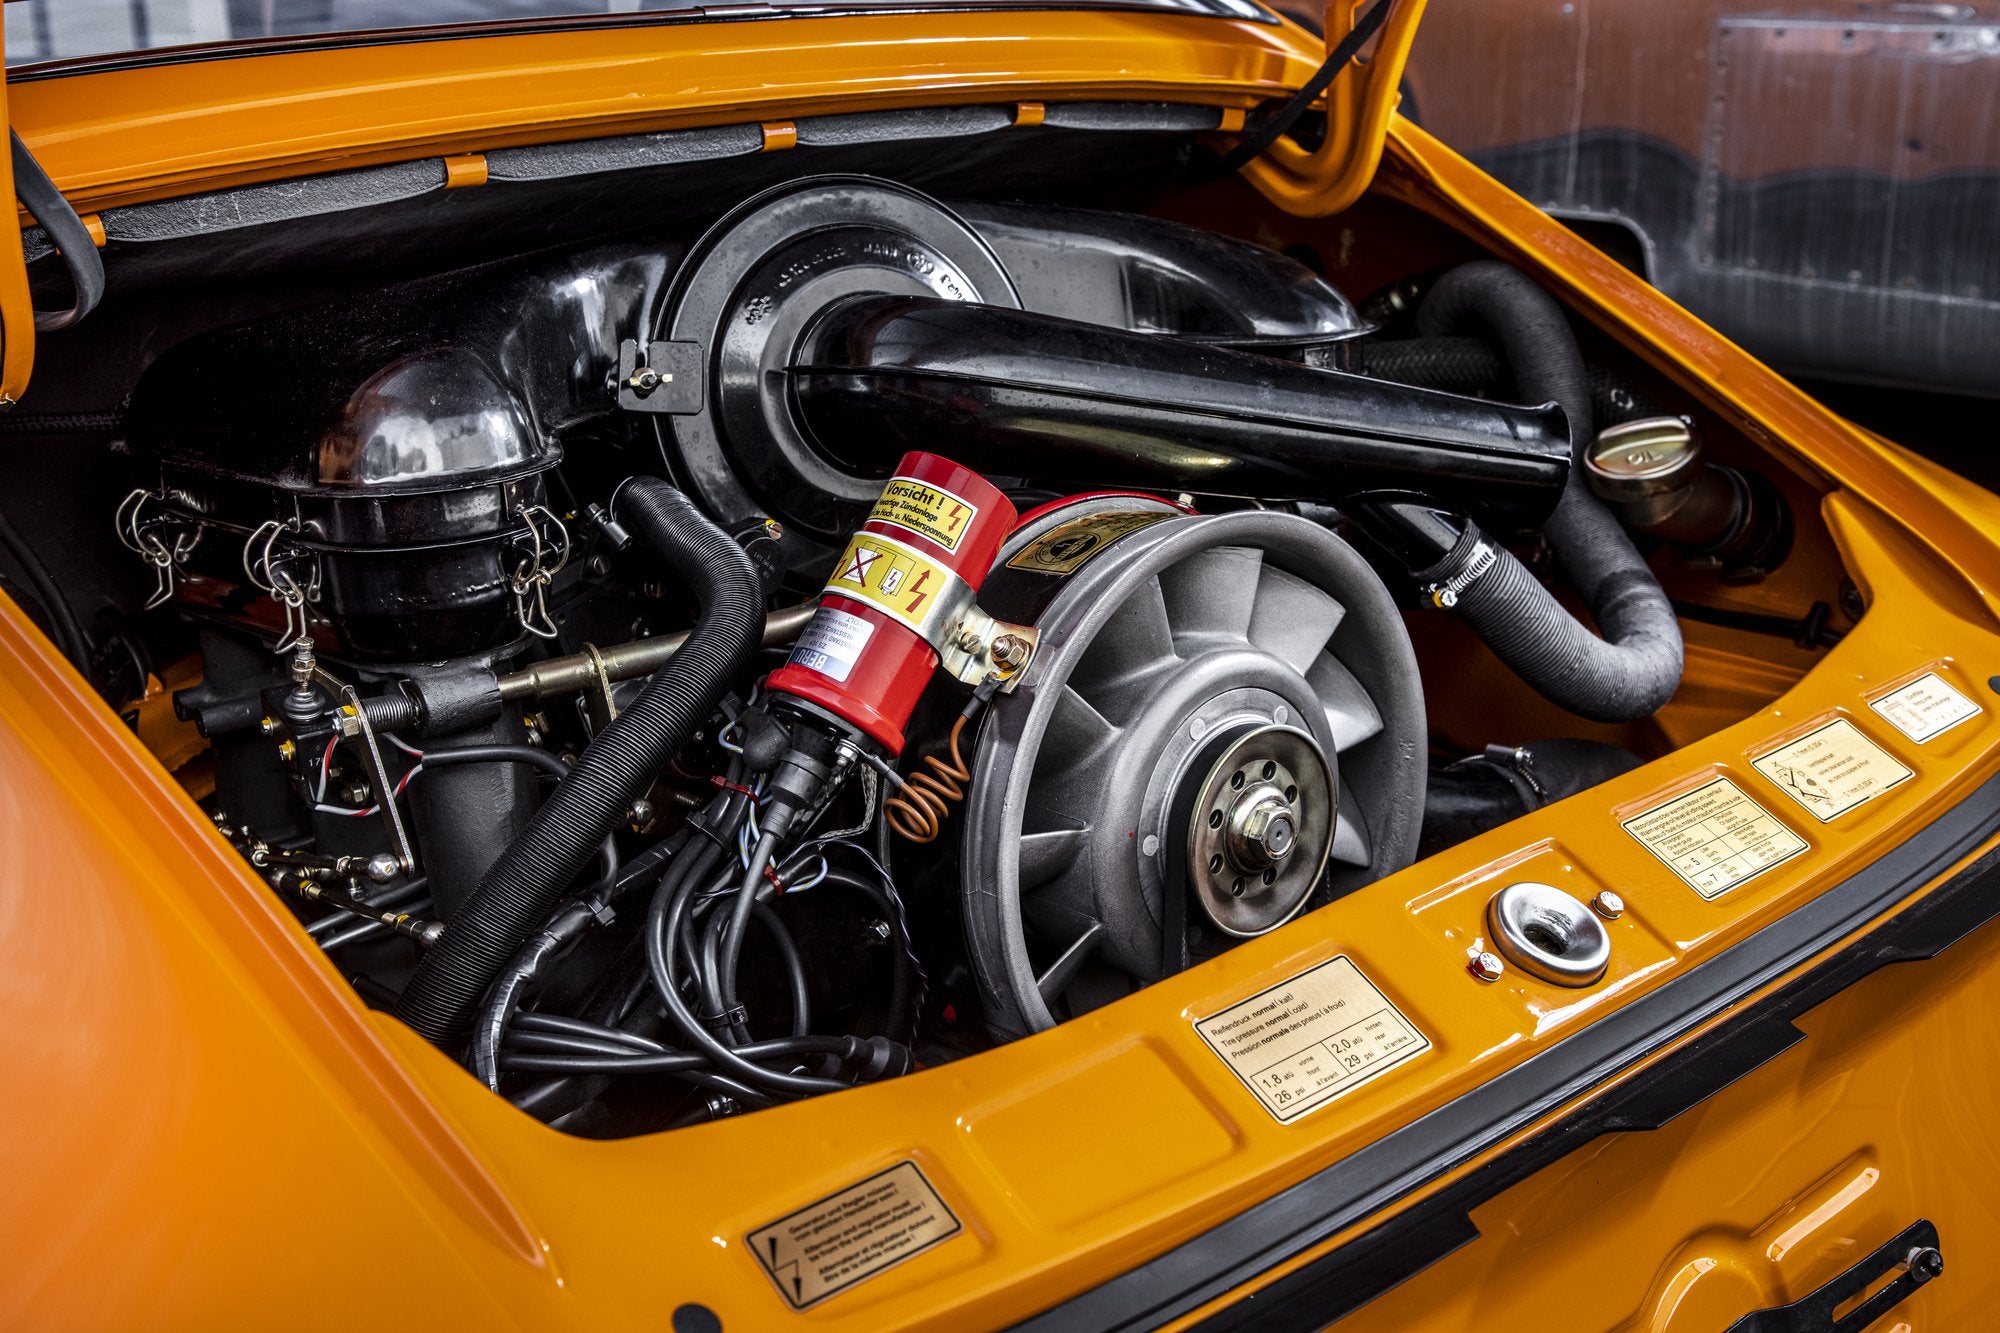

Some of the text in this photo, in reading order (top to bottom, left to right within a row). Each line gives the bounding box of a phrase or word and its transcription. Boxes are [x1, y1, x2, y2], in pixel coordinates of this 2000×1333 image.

[1627, 450, 1664, 466] OIL
[887, 482, 935, 505] Vorsicht
[899, 500, 938, 522] Zündanlage
[901, 513, 955, 546] Niederspannung
[796, 649, 828, 670] BERU
[308, 757, 324, 767] 17
[1690, 857, 1700, 866] 5
[1709, 873, 1718, 881] 7
[1211, 1015, 1251, 1036] Reifendruck
[1252, 1002, 1277, 1018] normal
[1365, 1021, 1382, 1031] hinten
[1221, 1038, 1237, 1047] Tire
[1235, 1025, 1265, 1042] pressure
[1265, 1011, 1290, 1027] normal
[1231, 1042, 1262, 1058] Pression
[1261, 1028, 1290, 1044] normale
[1288, 1022, 1302, 1031] des
[1300, 1012, 1322, 1026] pneus
[1331, 1039, 1351, 1054] 2,0
[1299, 1056, 1314, 1066] vorne
[1344, 1052, 1374, 1068] 29 psi
[1306, 1066, 1320, 1076] front
[1263, 1074, 1282, 1088] 1,8
[1274, 1088, 1305, 1104] 26 psi
